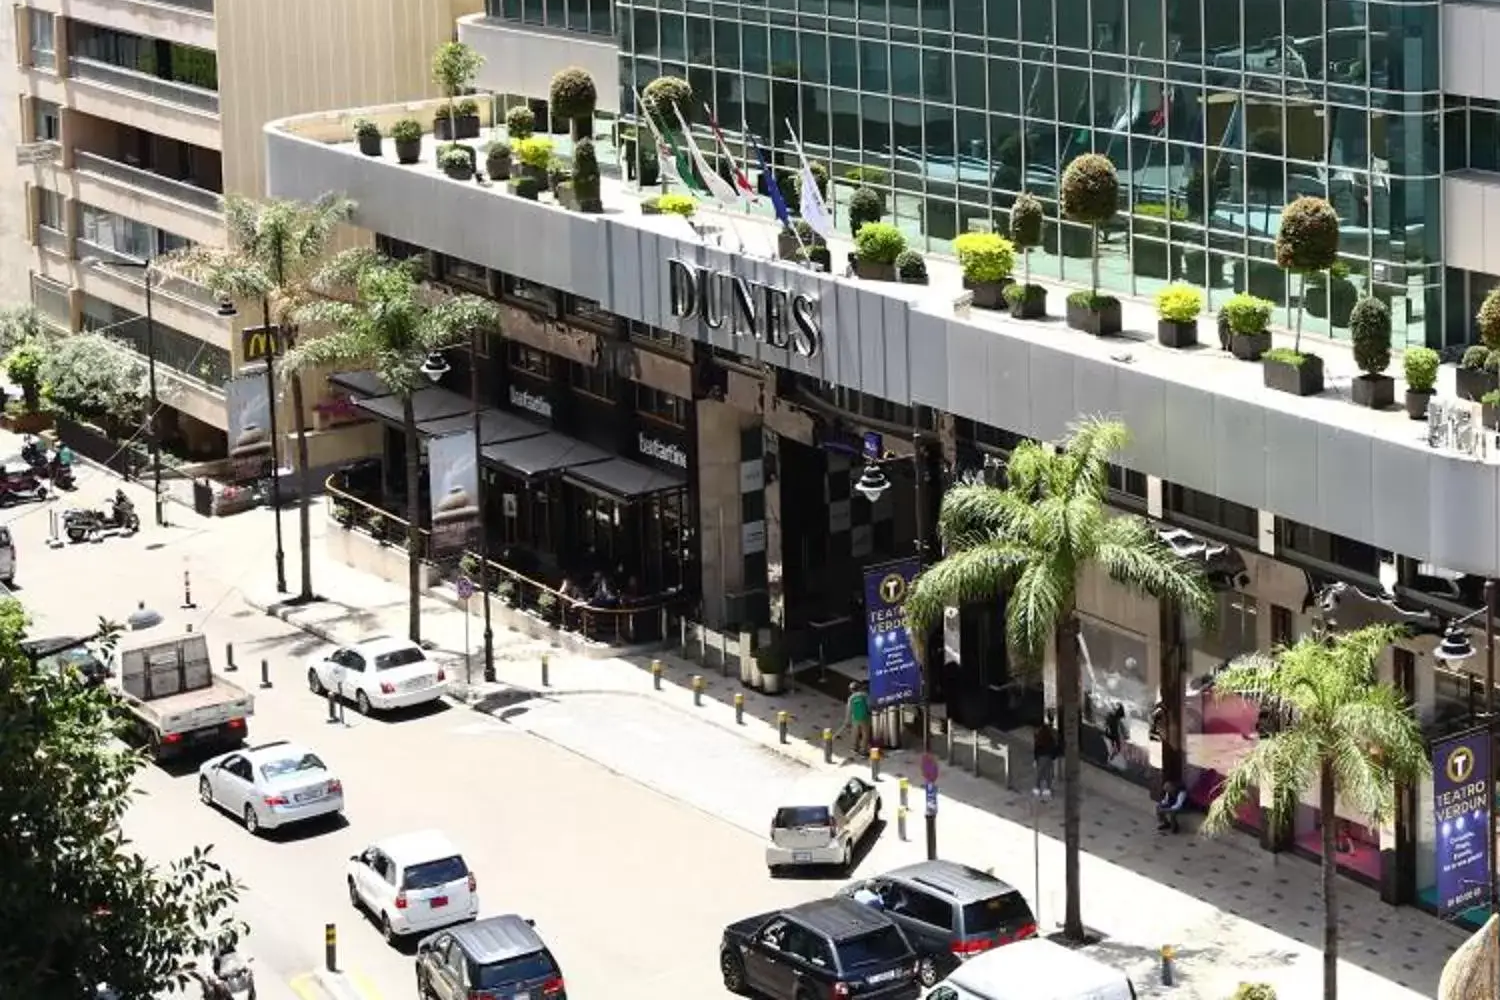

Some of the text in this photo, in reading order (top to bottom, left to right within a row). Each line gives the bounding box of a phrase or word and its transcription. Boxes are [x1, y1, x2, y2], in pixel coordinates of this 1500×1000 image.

[668, 258, 823, 359] DUNES
[1436, 780, 1486, 807] TEATRO
[1436, 794, 1487, 822] VERDUN
